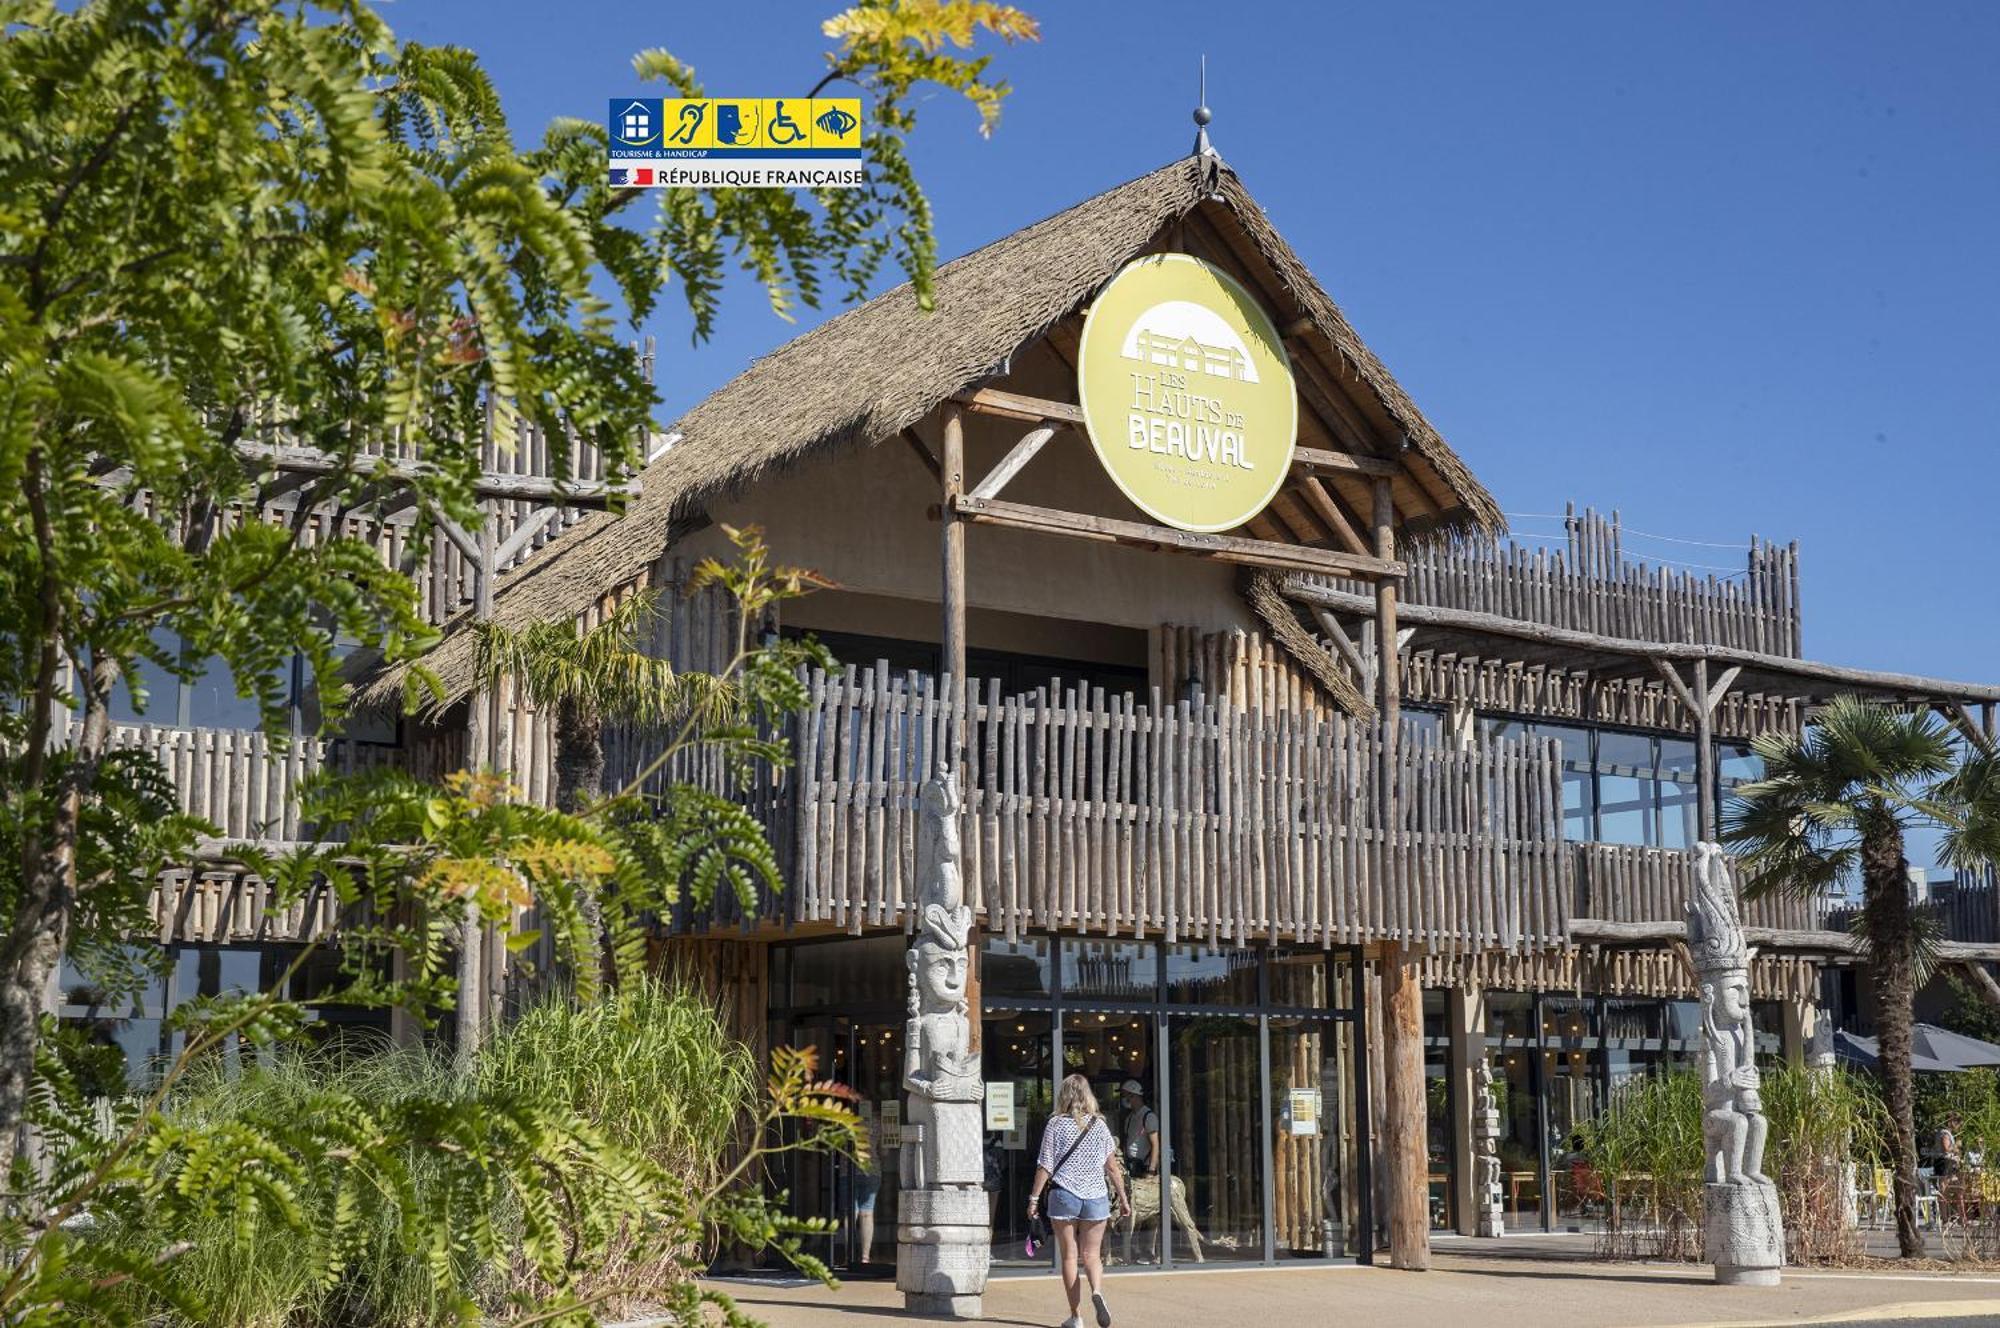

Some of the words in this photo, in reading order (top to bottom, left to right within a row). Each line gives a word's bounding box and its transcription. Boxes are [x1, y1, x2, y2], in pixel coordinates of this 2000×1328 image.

[1130, 373, 1222, 425] HAUTS
[1225, 412, 1245, 430] DE
[1160, 371, 1186, 390] LES
[1128, 413, 1255, 471] BEAUVAL
